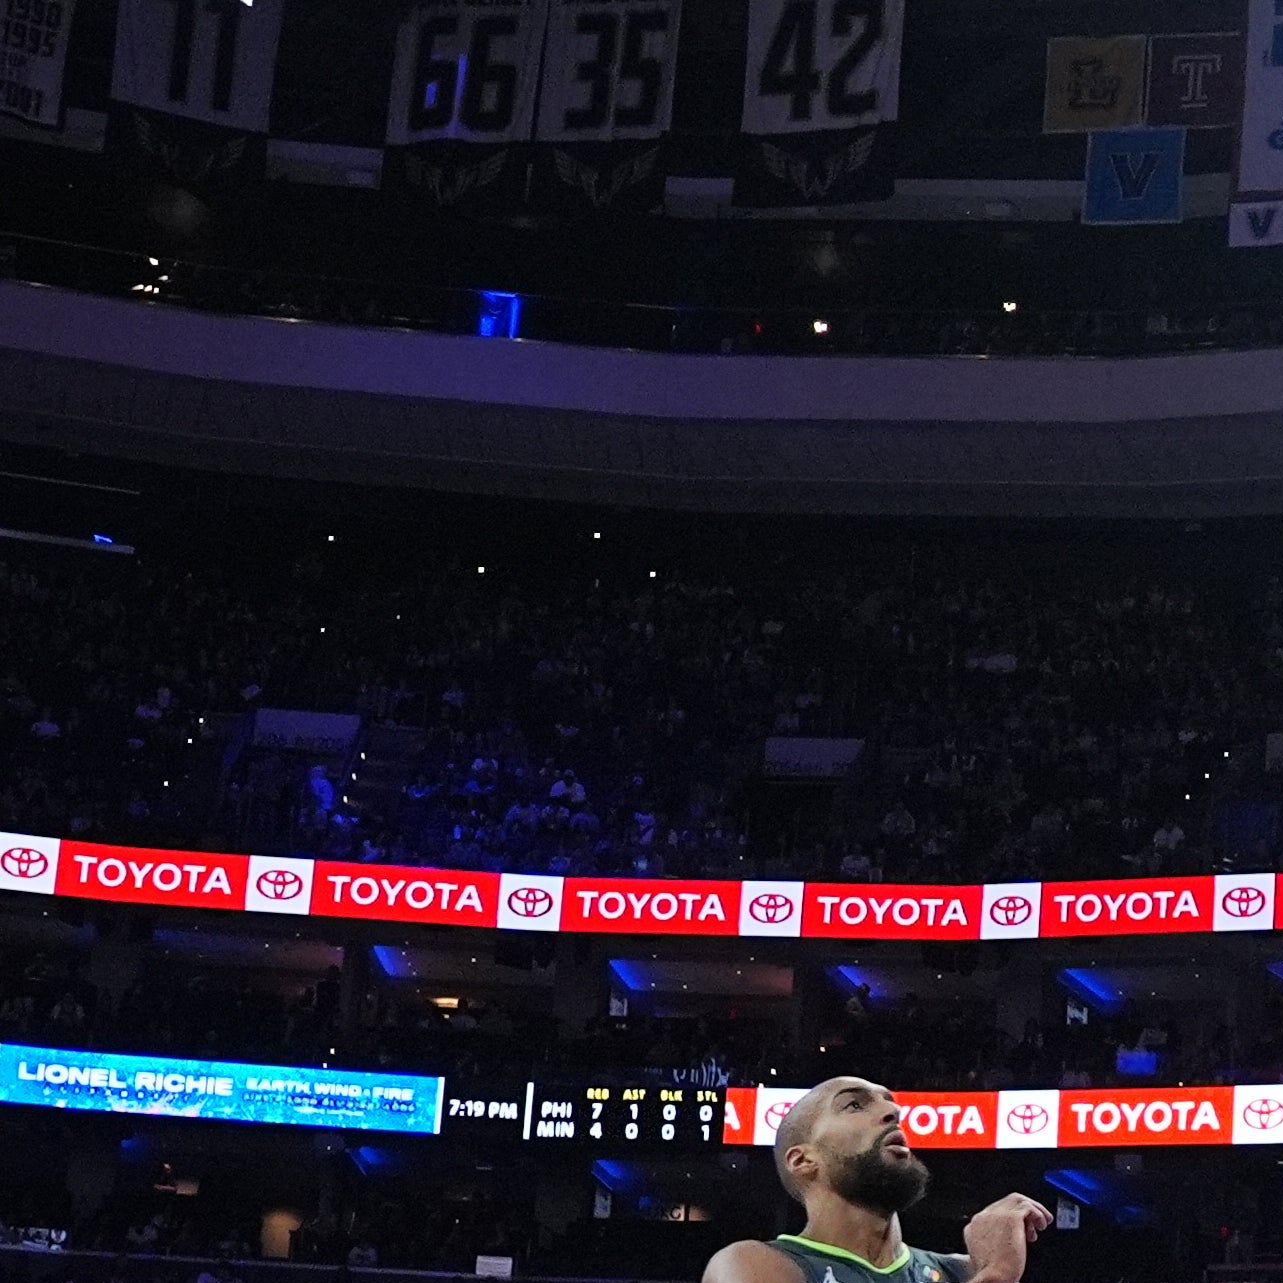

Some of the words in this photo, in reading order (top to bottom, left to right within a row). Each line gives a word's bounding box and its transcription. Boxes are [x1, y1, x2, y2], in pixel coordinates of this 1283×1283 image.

[409, 15, 517, 131] 66
[564, 12, 668, 128] 35
[759, 0, 886, 121] 42
[1172, 54, 1222, 109] T
[1110, 152, 1158, 200] V
[1247, 207, 1276, 239] V
[74, 855, 231, 894] TOYOTA
[328, 876, 482, 912] TOYOTA
[577, 891, 725, 922] TOYOTA
[1054, 891, 1199, 922] TOYOTA
[818, 897, 967, 926] TOYOTA
[18, 1061, 127, 1089] LIONEL
[135, 1071, 233, 1096] RICHIE
[314, 1083, 362, 1097] WIND
[372, 1087, 414, 1101] FIRE
[449, 1099, 486, 1117] 7:19
[488, 1102, 518, 1119] PM
[541, 1101, 572, 1118] PHI
[591, 1102, 603, 1119] 7
[630, 1104, 638, 1119] 1
[662, 1104, 676, 1121] 0
[699, 1105, 713, 1121] 0
[623, 1089, 646, 1101] AST
[697, 1091, 718, 1102] STL
[536, 1121, 574, 1138] MIN
[589, 1122, 603, 1139] 4
[624, 1123, 639, 1140] 0
[661, 1124, 675, 1140] 0
[701, 1125, 710, 1141] 1
[1071, 1101, 1220, 1133] TOYOTA
